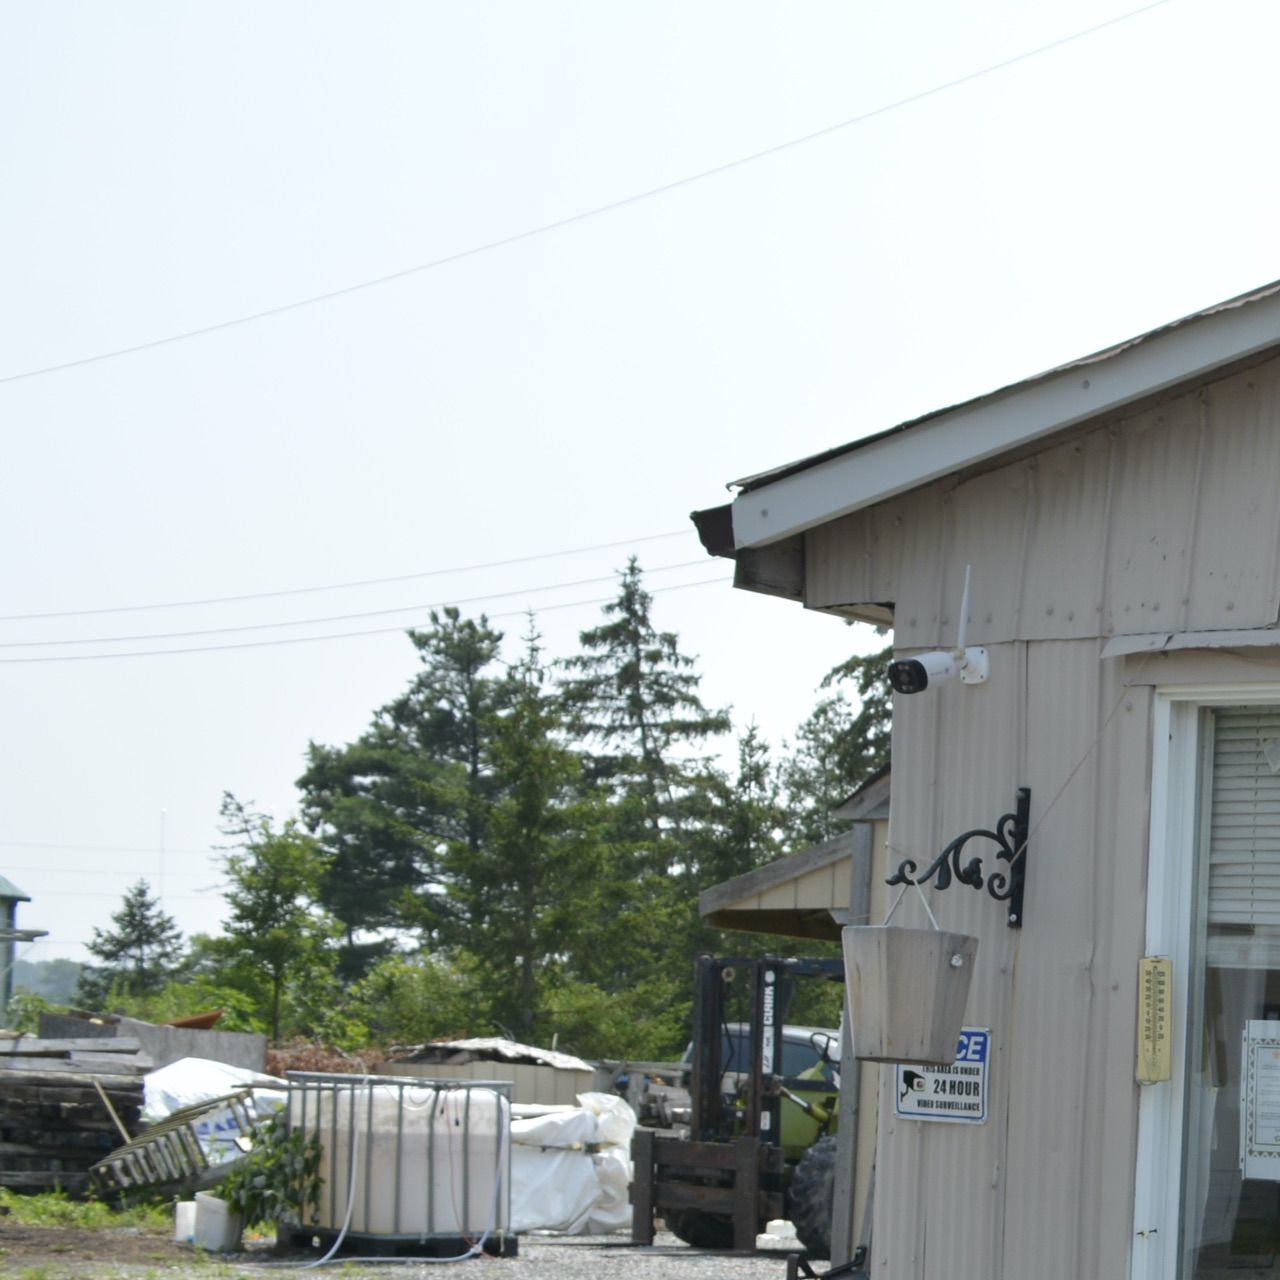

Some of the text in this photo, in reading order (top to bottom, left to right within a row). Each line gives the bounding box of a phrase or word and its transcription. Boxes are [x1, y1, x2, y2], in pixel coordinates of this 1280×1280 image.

[933, 1079, 980, 1097] 24 HOUR
[935, 1099, 980, 1112] SURVEILLANCE
